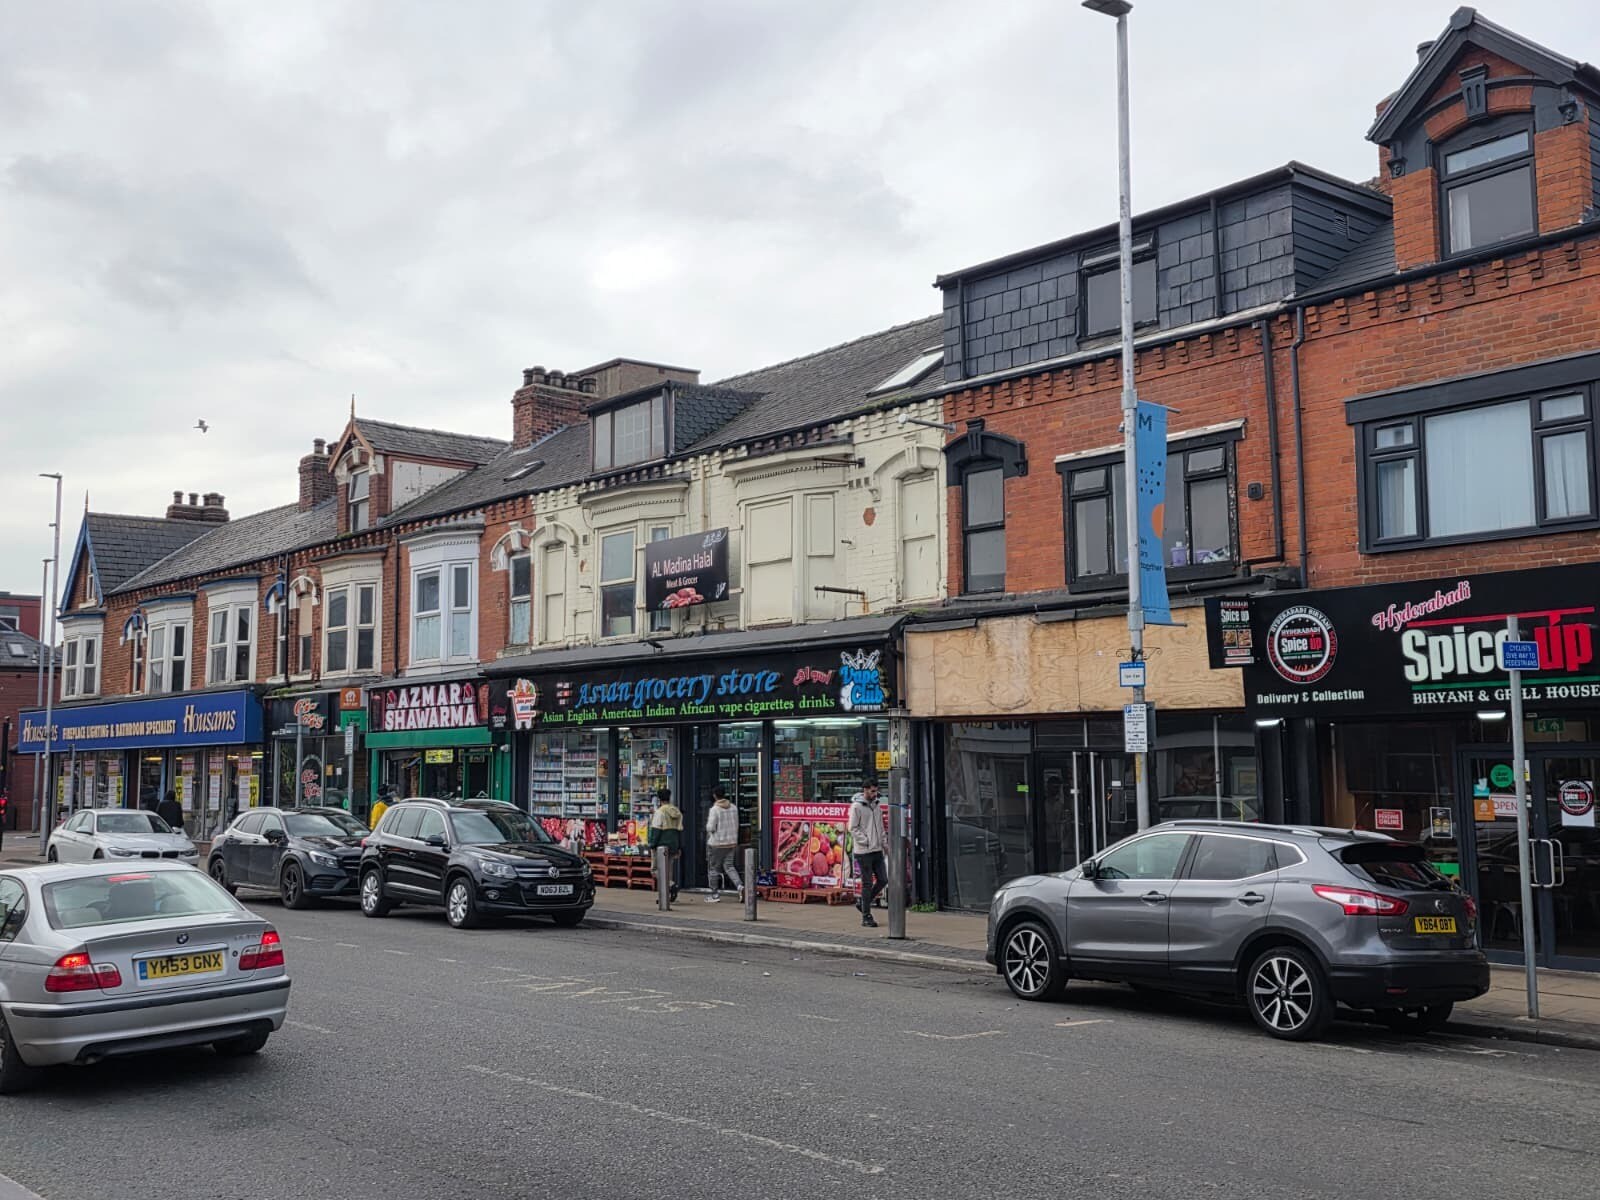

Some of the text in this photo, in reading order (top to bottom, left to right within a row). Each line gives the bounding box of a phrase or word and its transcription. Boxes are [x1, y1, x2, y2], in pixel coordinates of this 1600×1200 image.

[1138, 413, 1152, 432] M
[652, 549, 713, 578] AL Madina Halal
[1220, 609, 1240, 623] Spice
[1371, 580, 1472, 632] Hyderabadi
[1308, 608, 1332, 630] BIRYANI
[1281, 627, 1321, 637] HYDERABADI
[1281, 638, 1308, 653] Spice
[1309, 636, 1322, 650] up
[1509, 644, 1532, 652] CYCLISTS
[1534, 622, 1594, 672] up
[1504, 659, 1538, 667] PEDESTRIANS
[840, 665, 879, 687] Vape
[398, 683, 462, 709] AZMAR
[575, 668, 780, 709] Asian grocery store
[851, 683, 885, 705] Club
[1257, 689, 1365, 705] Delivery & Collection
[1412, 684, 1600, 705] BIRYANI & GRLL HOUSE
[183, 705, 237, 733] Housams
[384, 704, 476, 731] SHAWARMA
[542, 693, 835, 724] Asian English American Indian African vape cigarettes drinks
[115, 721, 145, 737] BATHROOM
[145, 719, 177, 736] SPECIALIST
[892, 719, 900, 765] TAXI
[779, 806, 847, 816] ASIAN GROCERY
[149, 954, 222, 974] YH53 GNX
